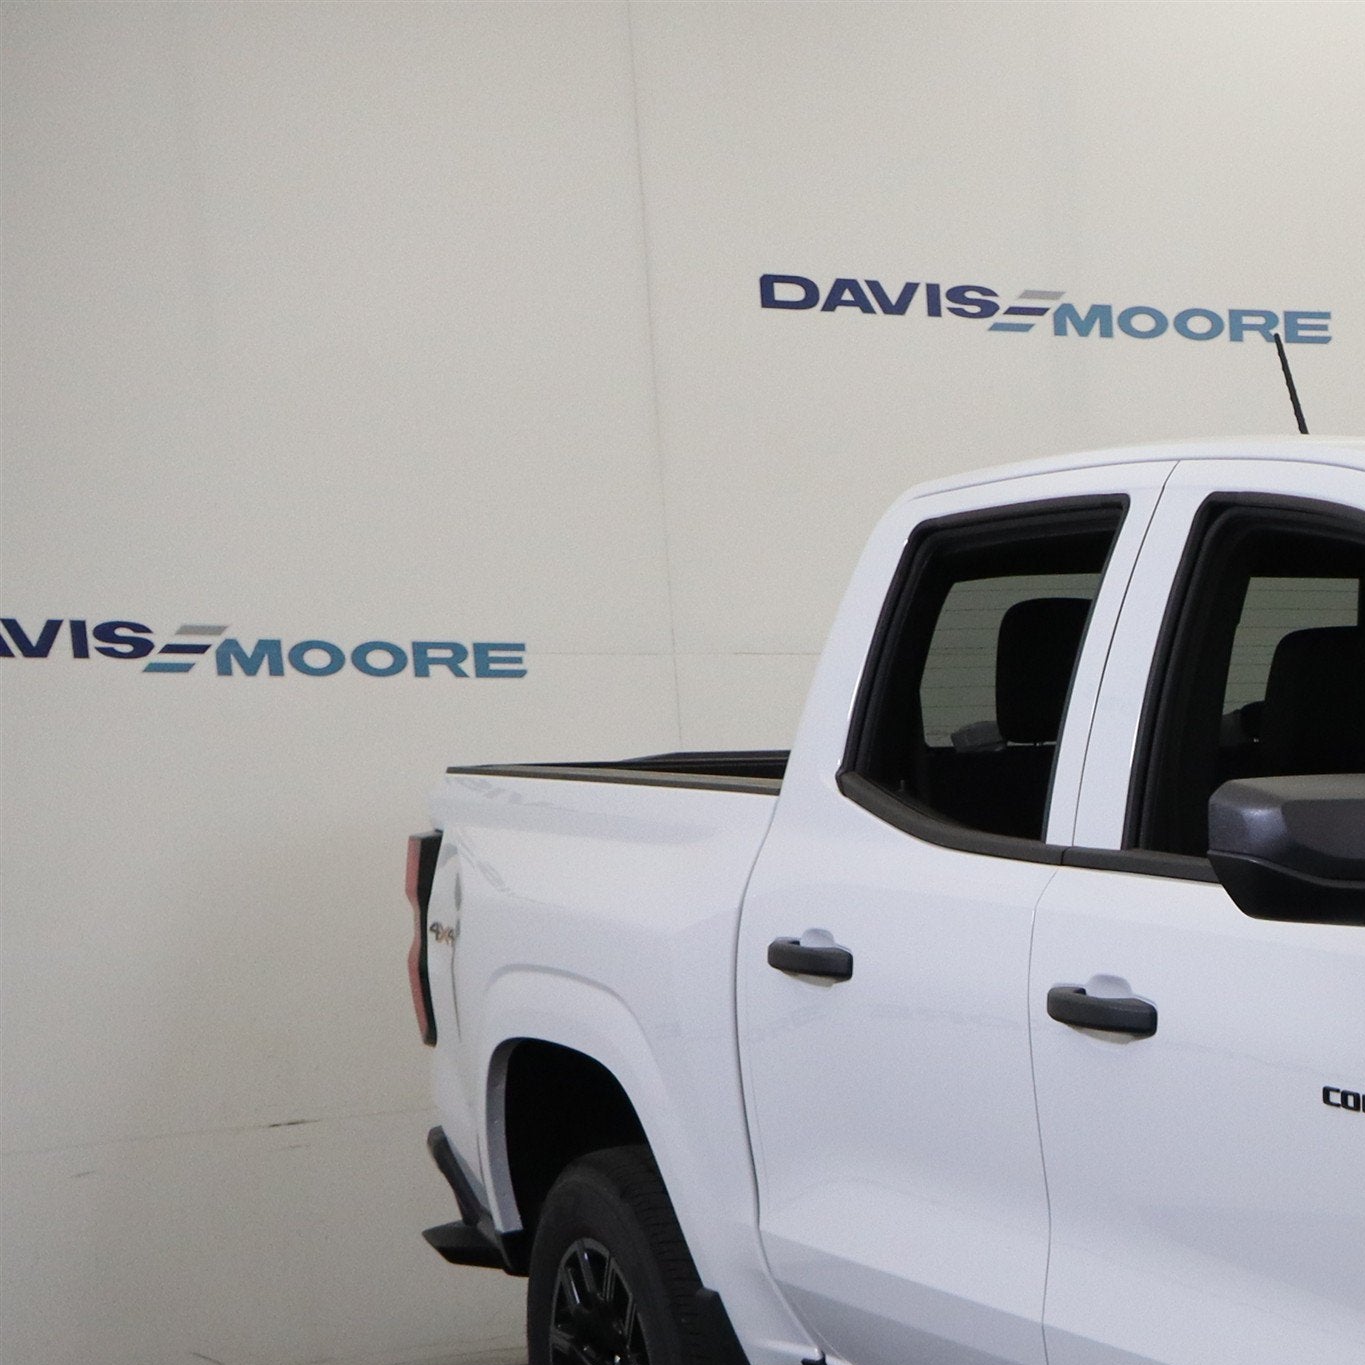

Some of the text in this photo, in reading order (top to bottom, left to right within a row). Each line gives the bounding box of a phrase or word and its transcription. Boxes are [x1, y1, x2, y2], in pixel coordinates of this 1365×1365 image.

[759, 273, 1332, 344] DAVIS MOORE
[0, 618, 528, 678] VIS MOORE
